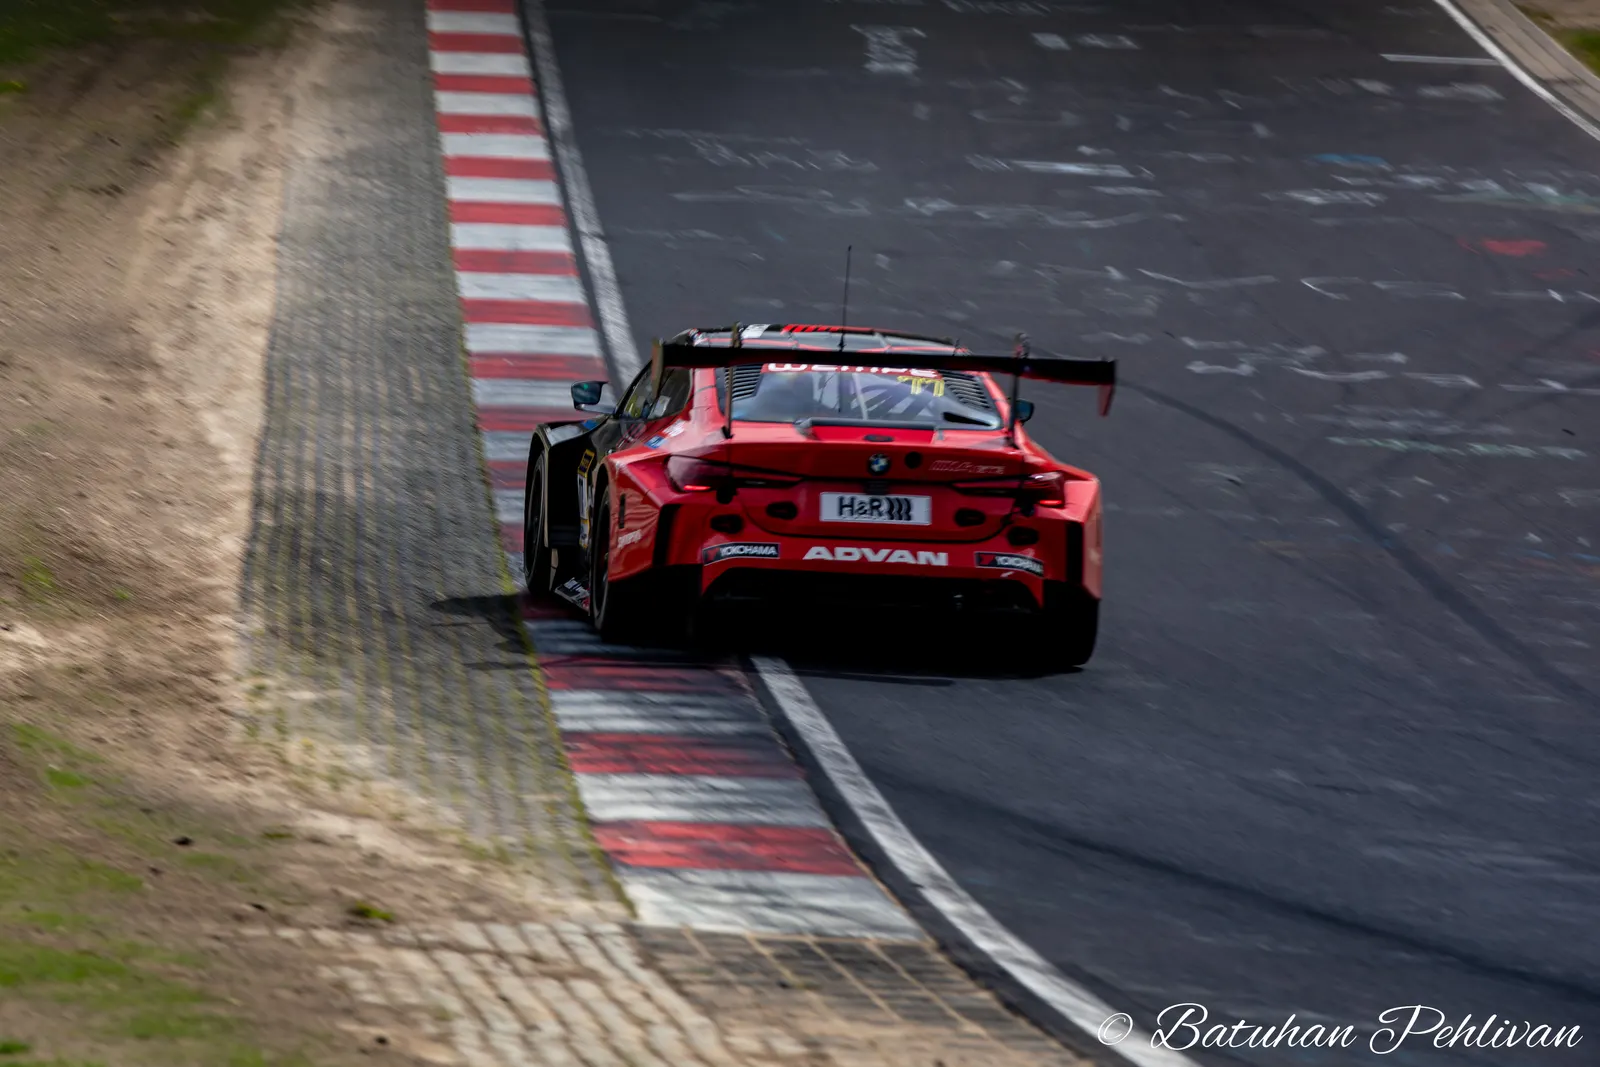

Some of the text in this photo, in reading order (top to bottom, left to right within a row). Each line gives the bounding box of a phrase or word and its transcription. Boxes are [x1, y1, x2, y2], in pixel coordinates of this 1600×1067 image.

[838, 496, 883, 516] H&R
[720, 545, 778, 557] YOKOHAMA
[803, 546, 948, 567] ADVAN
